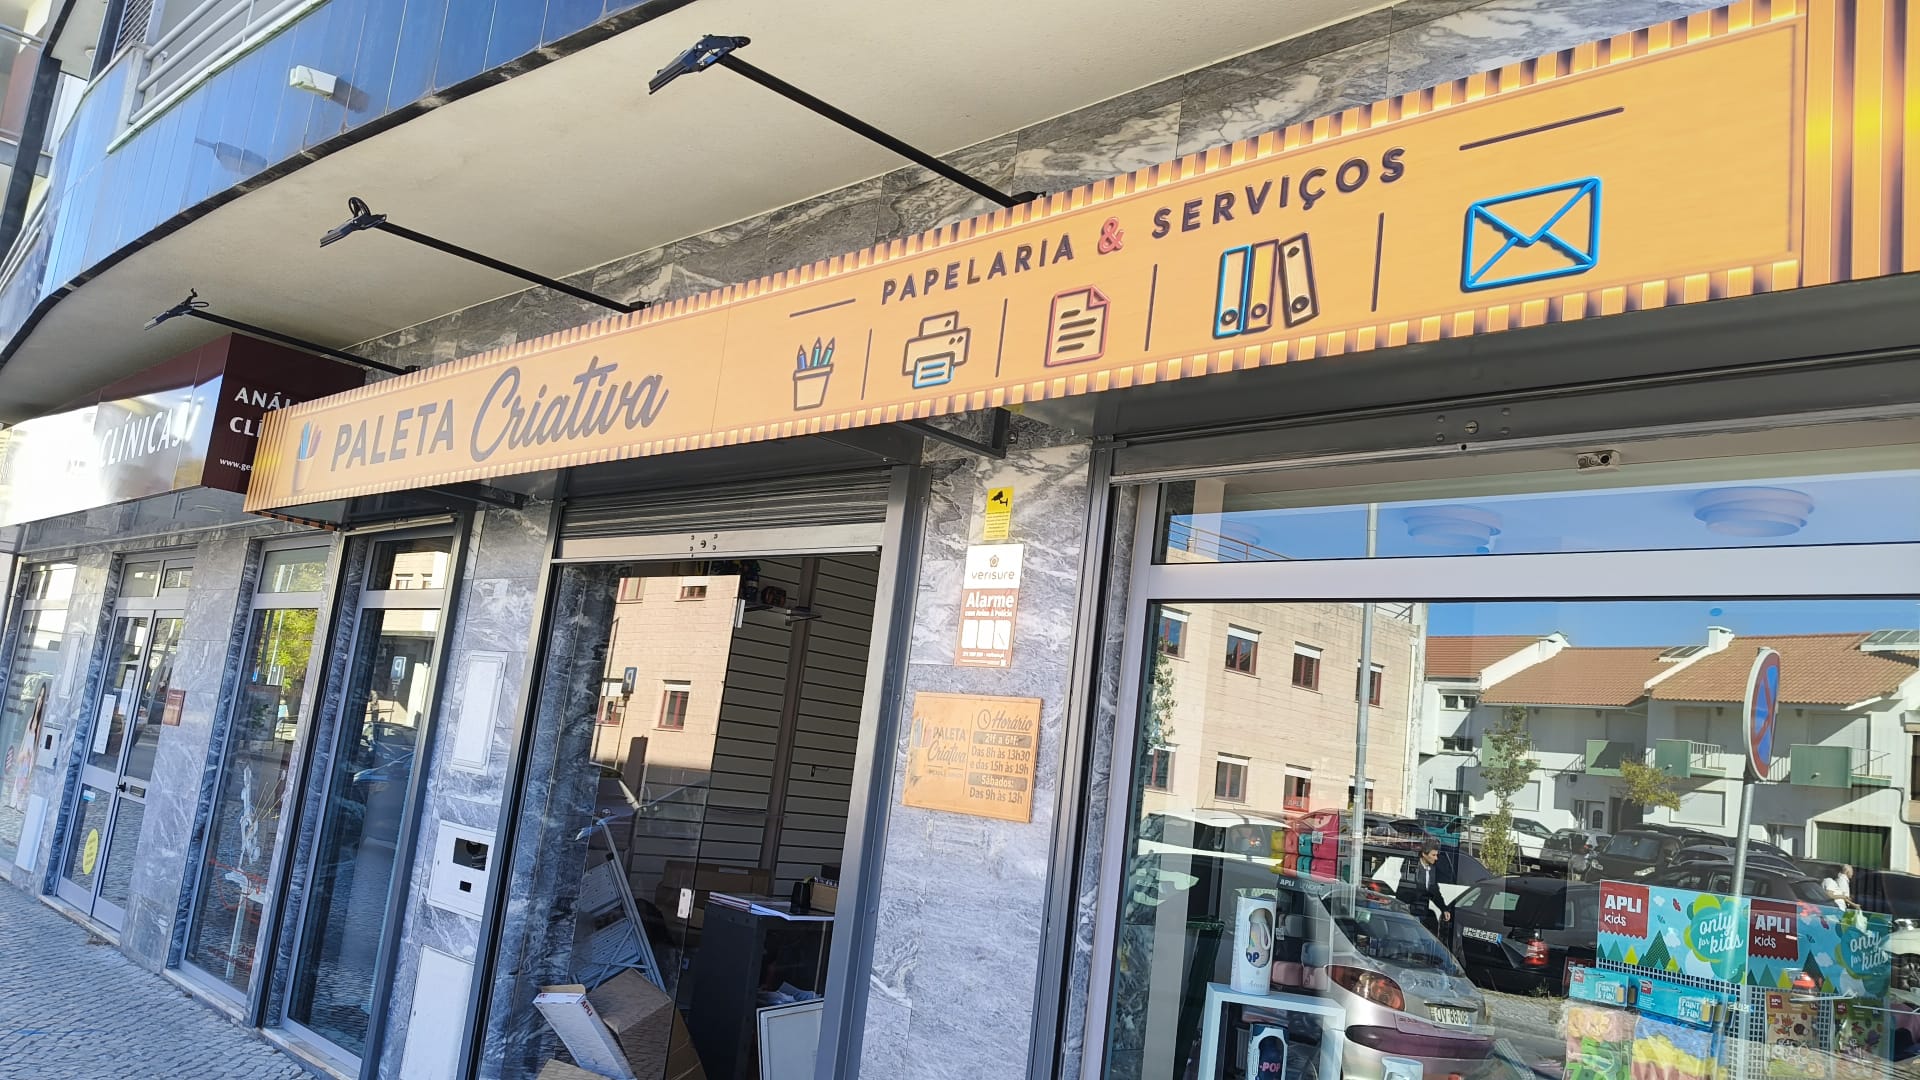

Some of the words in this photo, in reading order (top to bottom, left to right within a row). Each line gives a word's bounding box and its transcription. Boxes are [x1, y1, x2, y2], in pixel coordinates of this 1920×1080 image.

[881, 233, 1075, 306] PAPELARIA
[1098, 216, 1125, 254] &
[1151, 147, 1406, 239] SERVIÇOS
[330, 399, 454, 472] PALETA
[470, 355, 670, 463] Criativa
[971, 571, 1015, 581] verisure
[965, 591, 1015, 608] Alarme
[991, 710, 1033, 731] Horário
[933, 727, 966, 741] PALETA
[927, 740, 967, 764] Criativa
[1007, 749, 1031, 762] 13h30
[976, 758, 989, 770] das
[990, 761, 1003, 773] 15h
[1014, 763, 1029, 775] 19h
[970, 787, 984, 799] Das
[985, 789, 996, 801] 9h
[1007, 792, 1023, 804] 13h
[1279, 879, 1295, 887] APLI
[1604, 894, 1642, 913] APLI
[1604, 911, 1627, 926] kids
[1699, 913, 1732, 936] only
[1754, 915, 1791, 934] APLI
[1709, 931, 1744, 954] kids
[1754, 933, 1777, 949] kids
[1686, 1006, 1701, 1019] FUN
